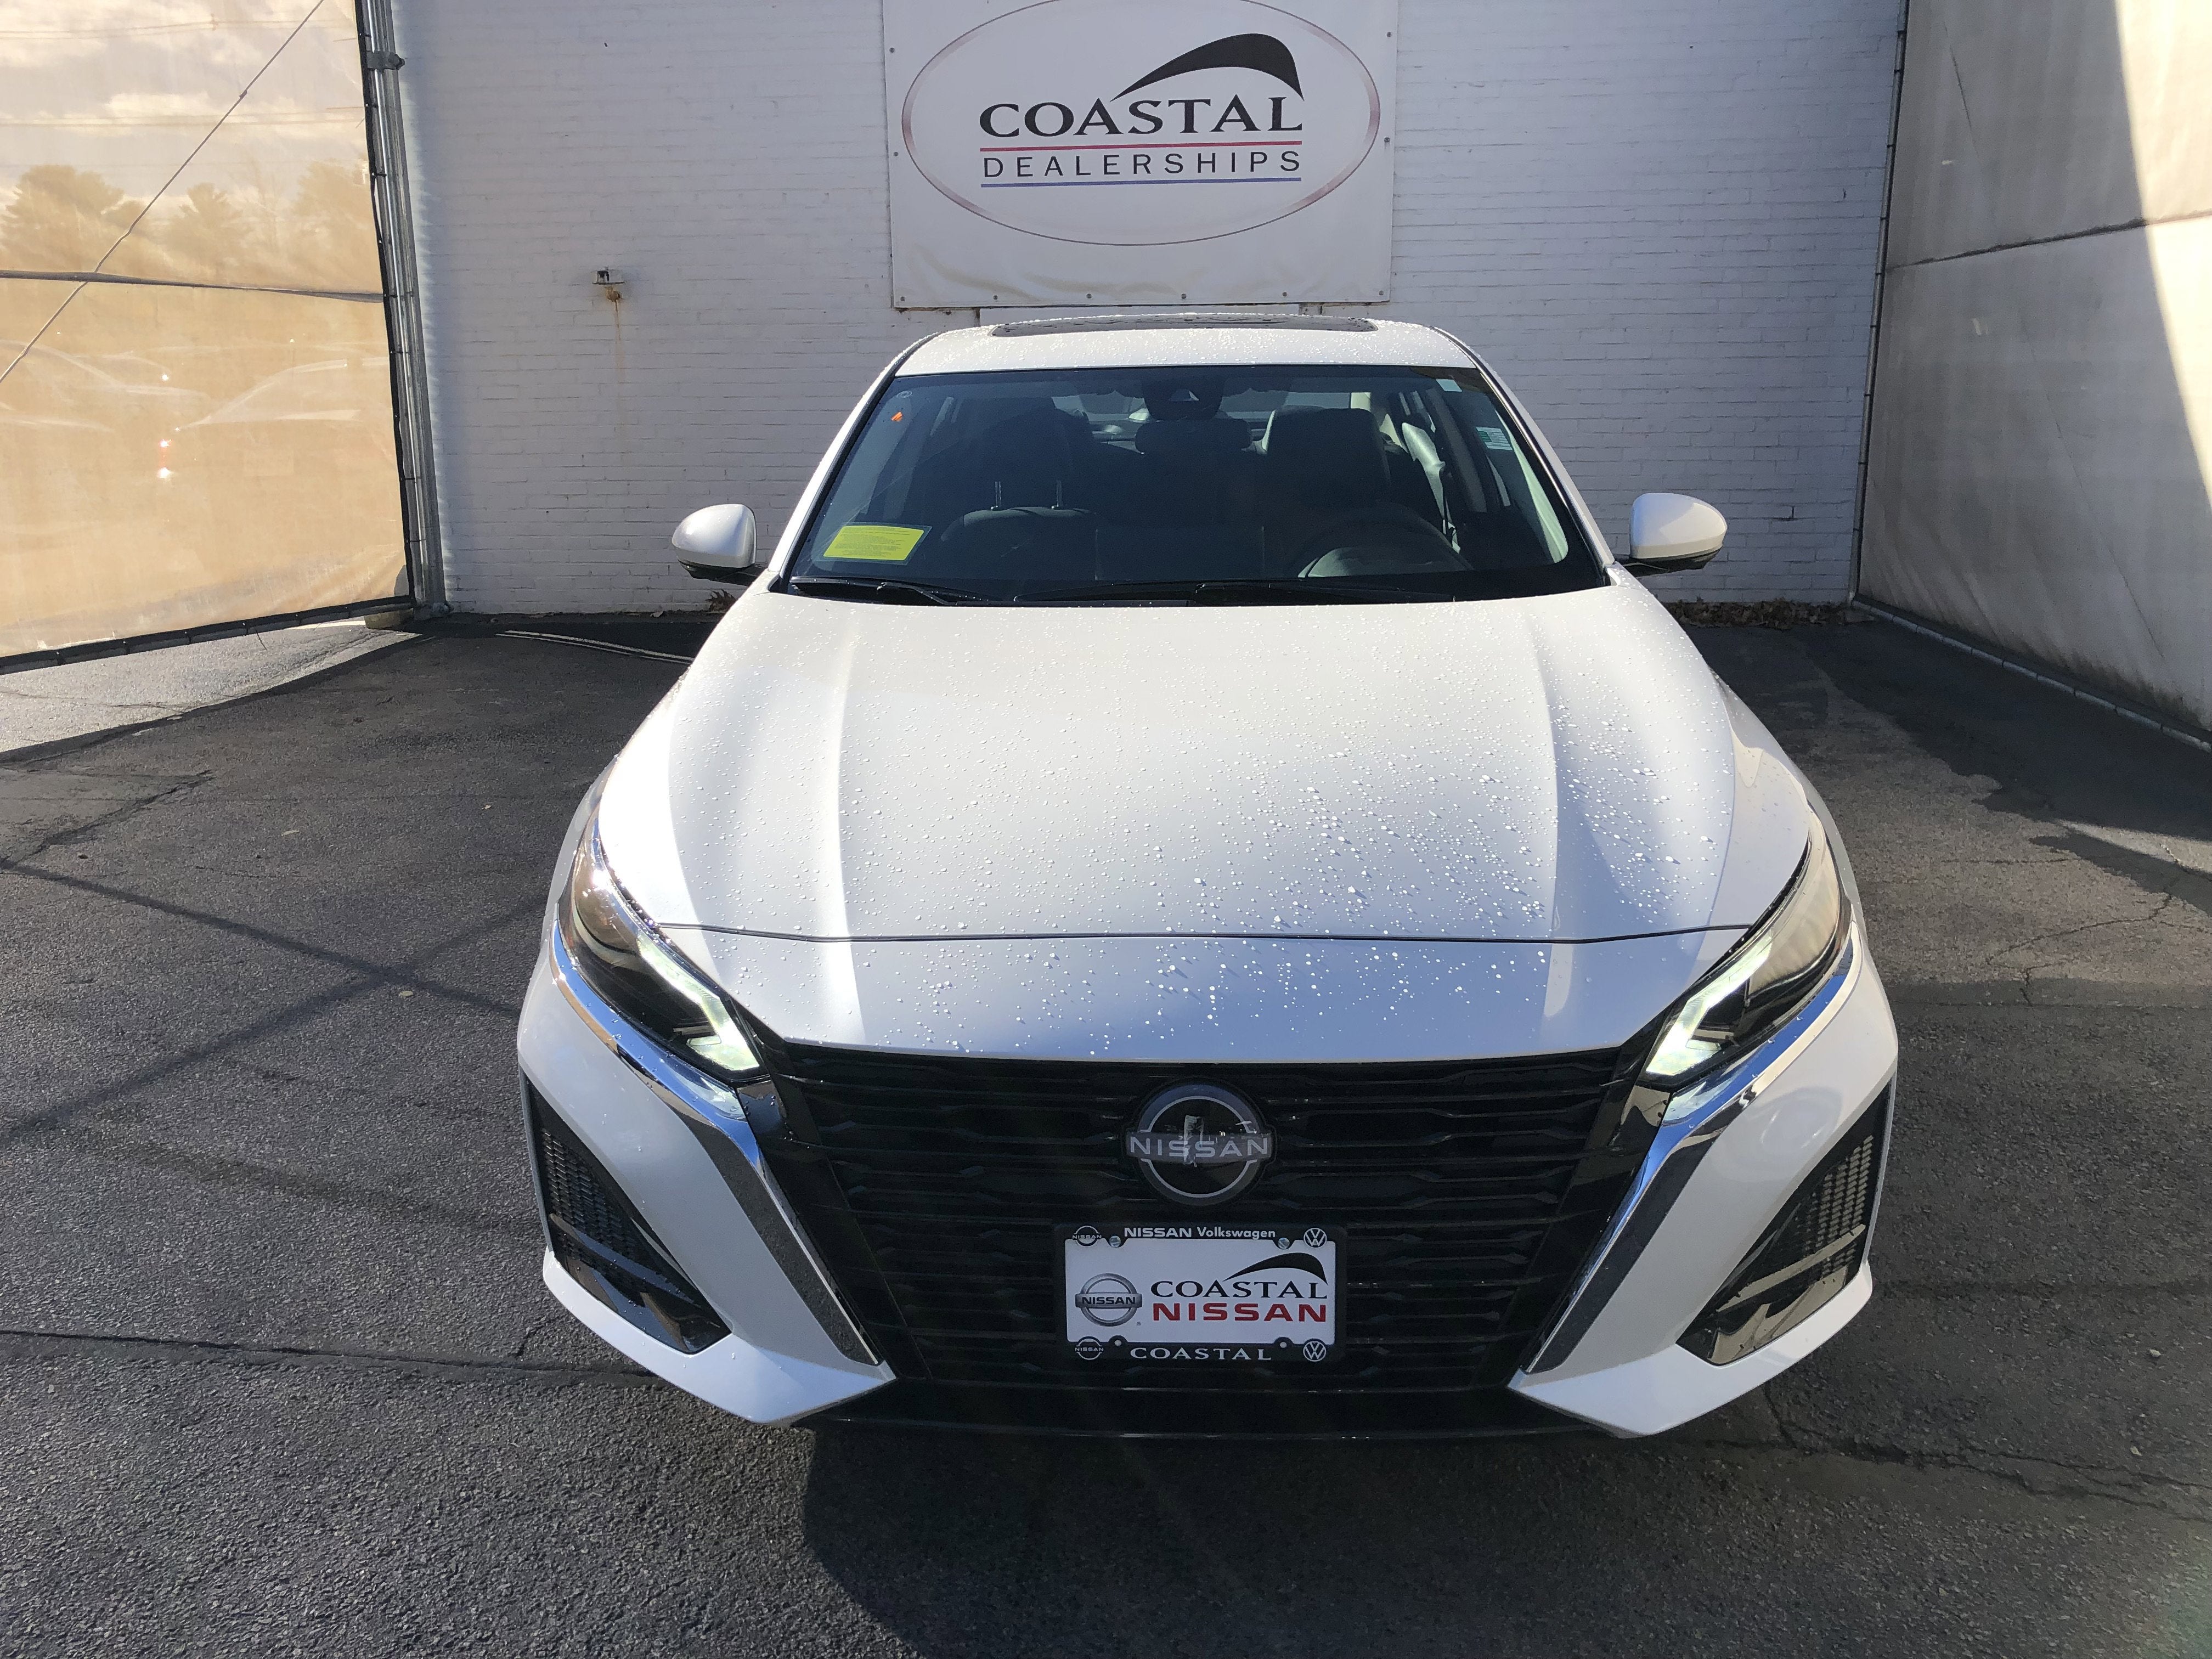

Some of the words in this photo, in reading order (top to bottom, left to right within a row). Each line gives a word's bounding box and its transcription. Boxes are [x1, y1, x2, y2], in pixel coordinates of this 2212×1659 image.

[979, 94, 1303, 138] COASTAL
[983, 150, 1301, 178] DEALERSHIPS
[1130, 1137, 1267, 1158] NISSAN
[1125, 1227, 1192, 1238] NISSAN
[1197, 1227, 1276, 1239] Volkswagen
[1150, 1279, 1328, 1299] COASTAL
[1082, 1296, 1136, 1305] NISSAN
[1153, 1302, 1326, 1322] NISSAN
[1130, 1347, 1271, 1361] COASTAL
